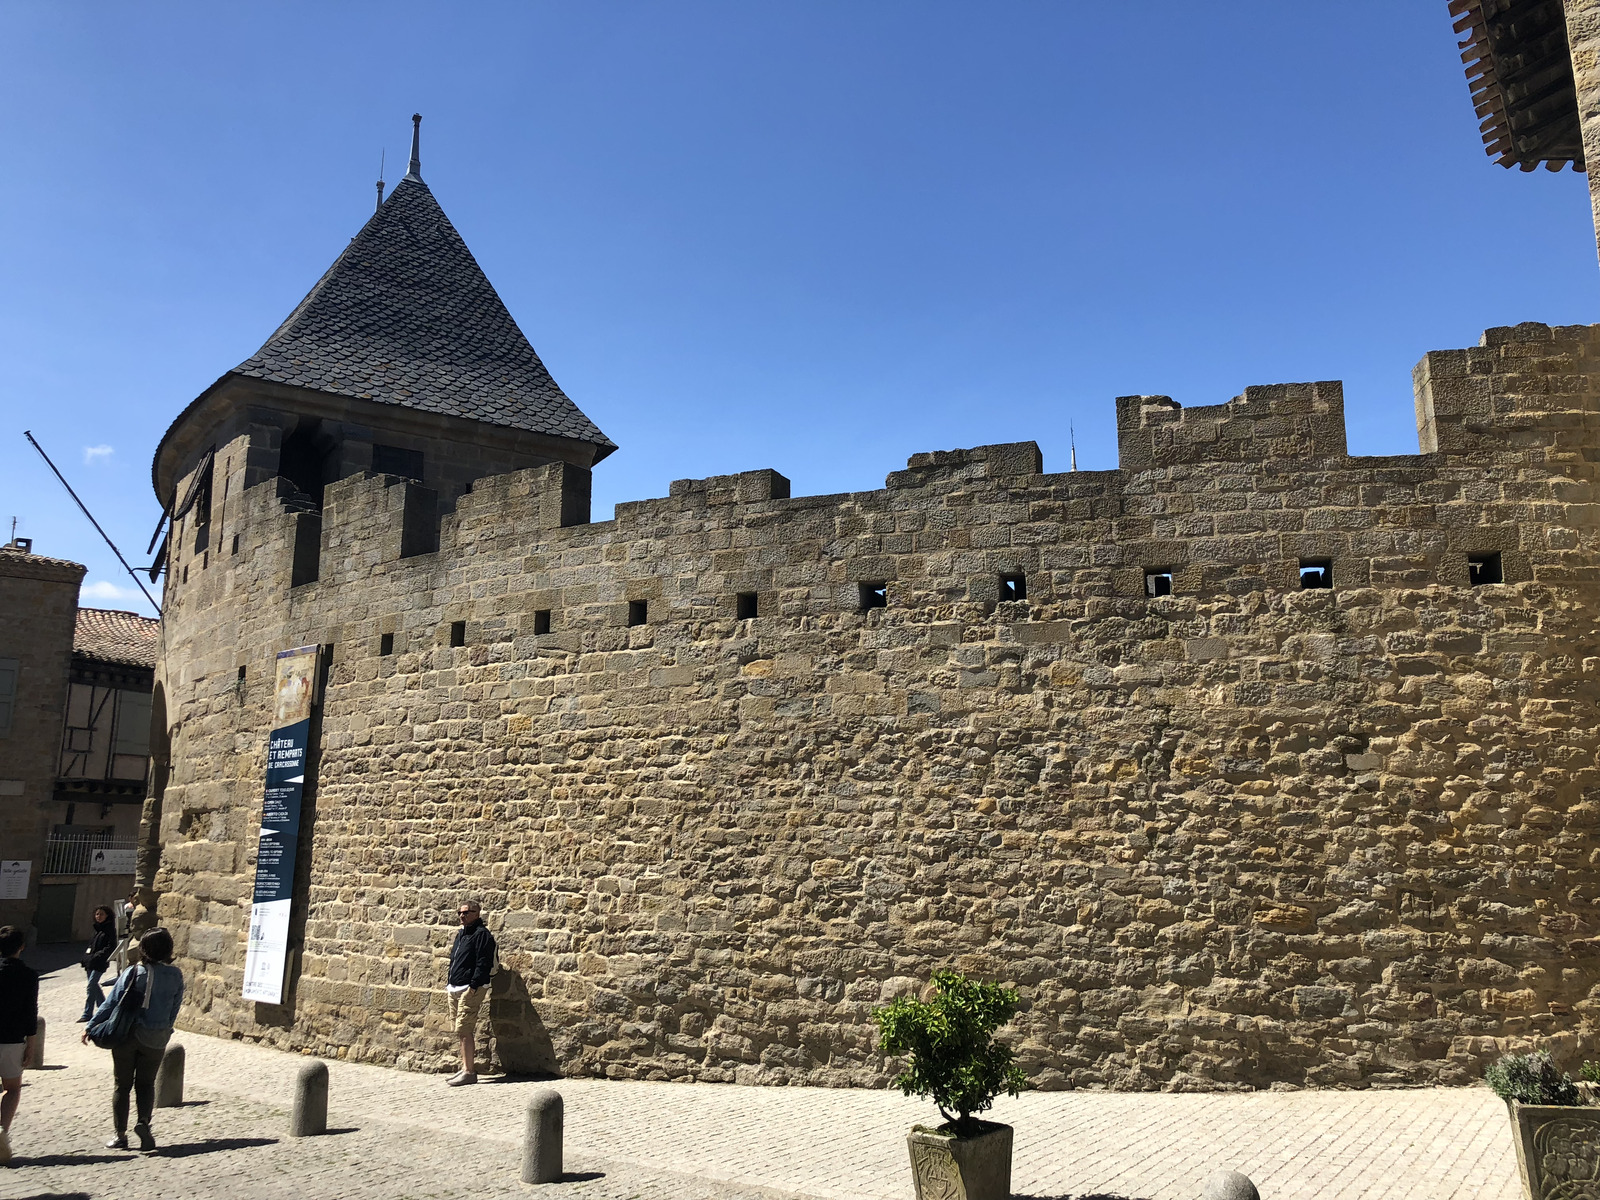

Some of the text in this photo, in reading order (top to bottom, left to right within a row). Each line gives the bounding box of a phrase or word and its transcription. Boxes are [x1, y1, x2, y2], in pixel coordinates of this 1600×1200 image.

[270, 738, 294, 750] CHÂTEAU
[269, 748, 303, 760] ET REMPARTS
[268, 760, 299, 769] DE CARCASSONNE
